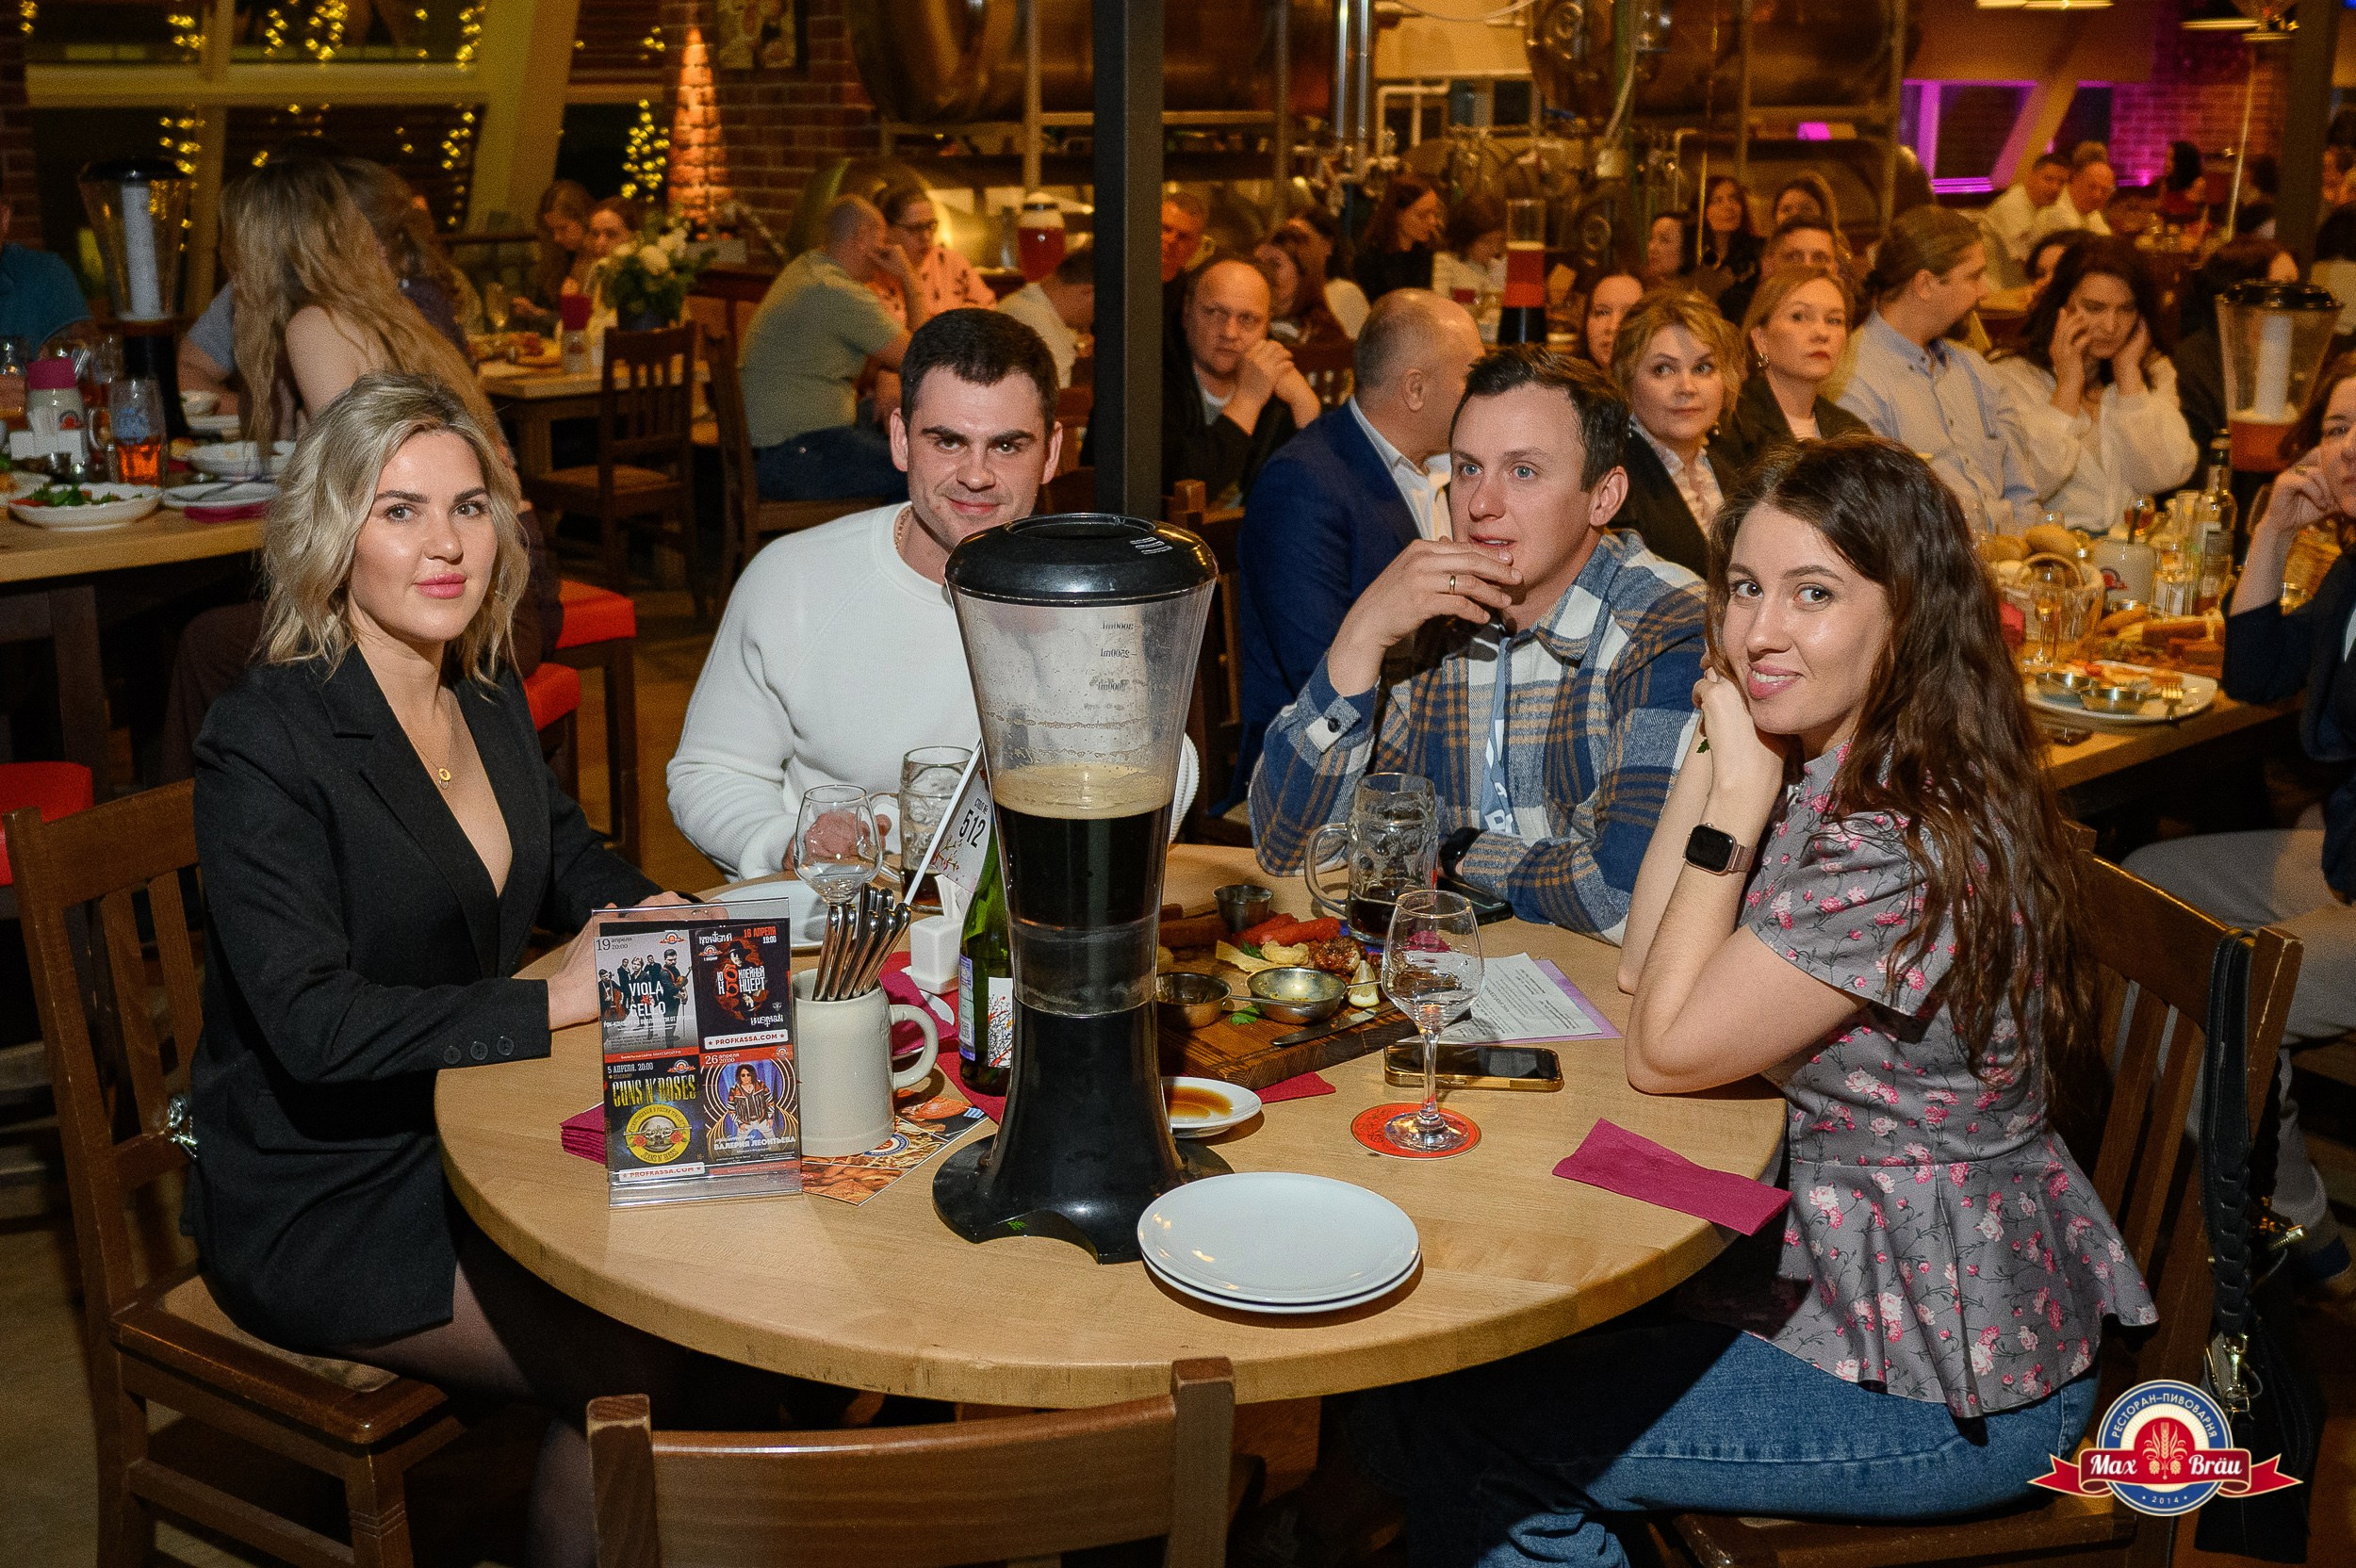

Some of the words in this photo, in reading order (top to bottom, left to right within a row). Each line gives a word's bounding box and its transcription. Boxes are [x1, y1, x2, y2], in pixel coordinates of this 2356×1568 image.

[959, 808, 986, 848] 512
[753, 926, 777, 938] АПРЕЛЯ
[597, 938, 612, 952] 19
[629, 981, 664, 997] VIOLA
[630, 1002, 666, 1017] CELLO
[714, 1034, 777, 1045] PROFKASSA.COM
[638, 1062, 653, 1070] 20:00
[705, 1054, 719, 1065] 26
[714, 1139, 750, 1150] ВАЛЕРИЯ
[751, 1136, 795, 1146] ЛЕОНТЬЕВА
[630, 1167, 694, 1178] PROFKASSA.COM
